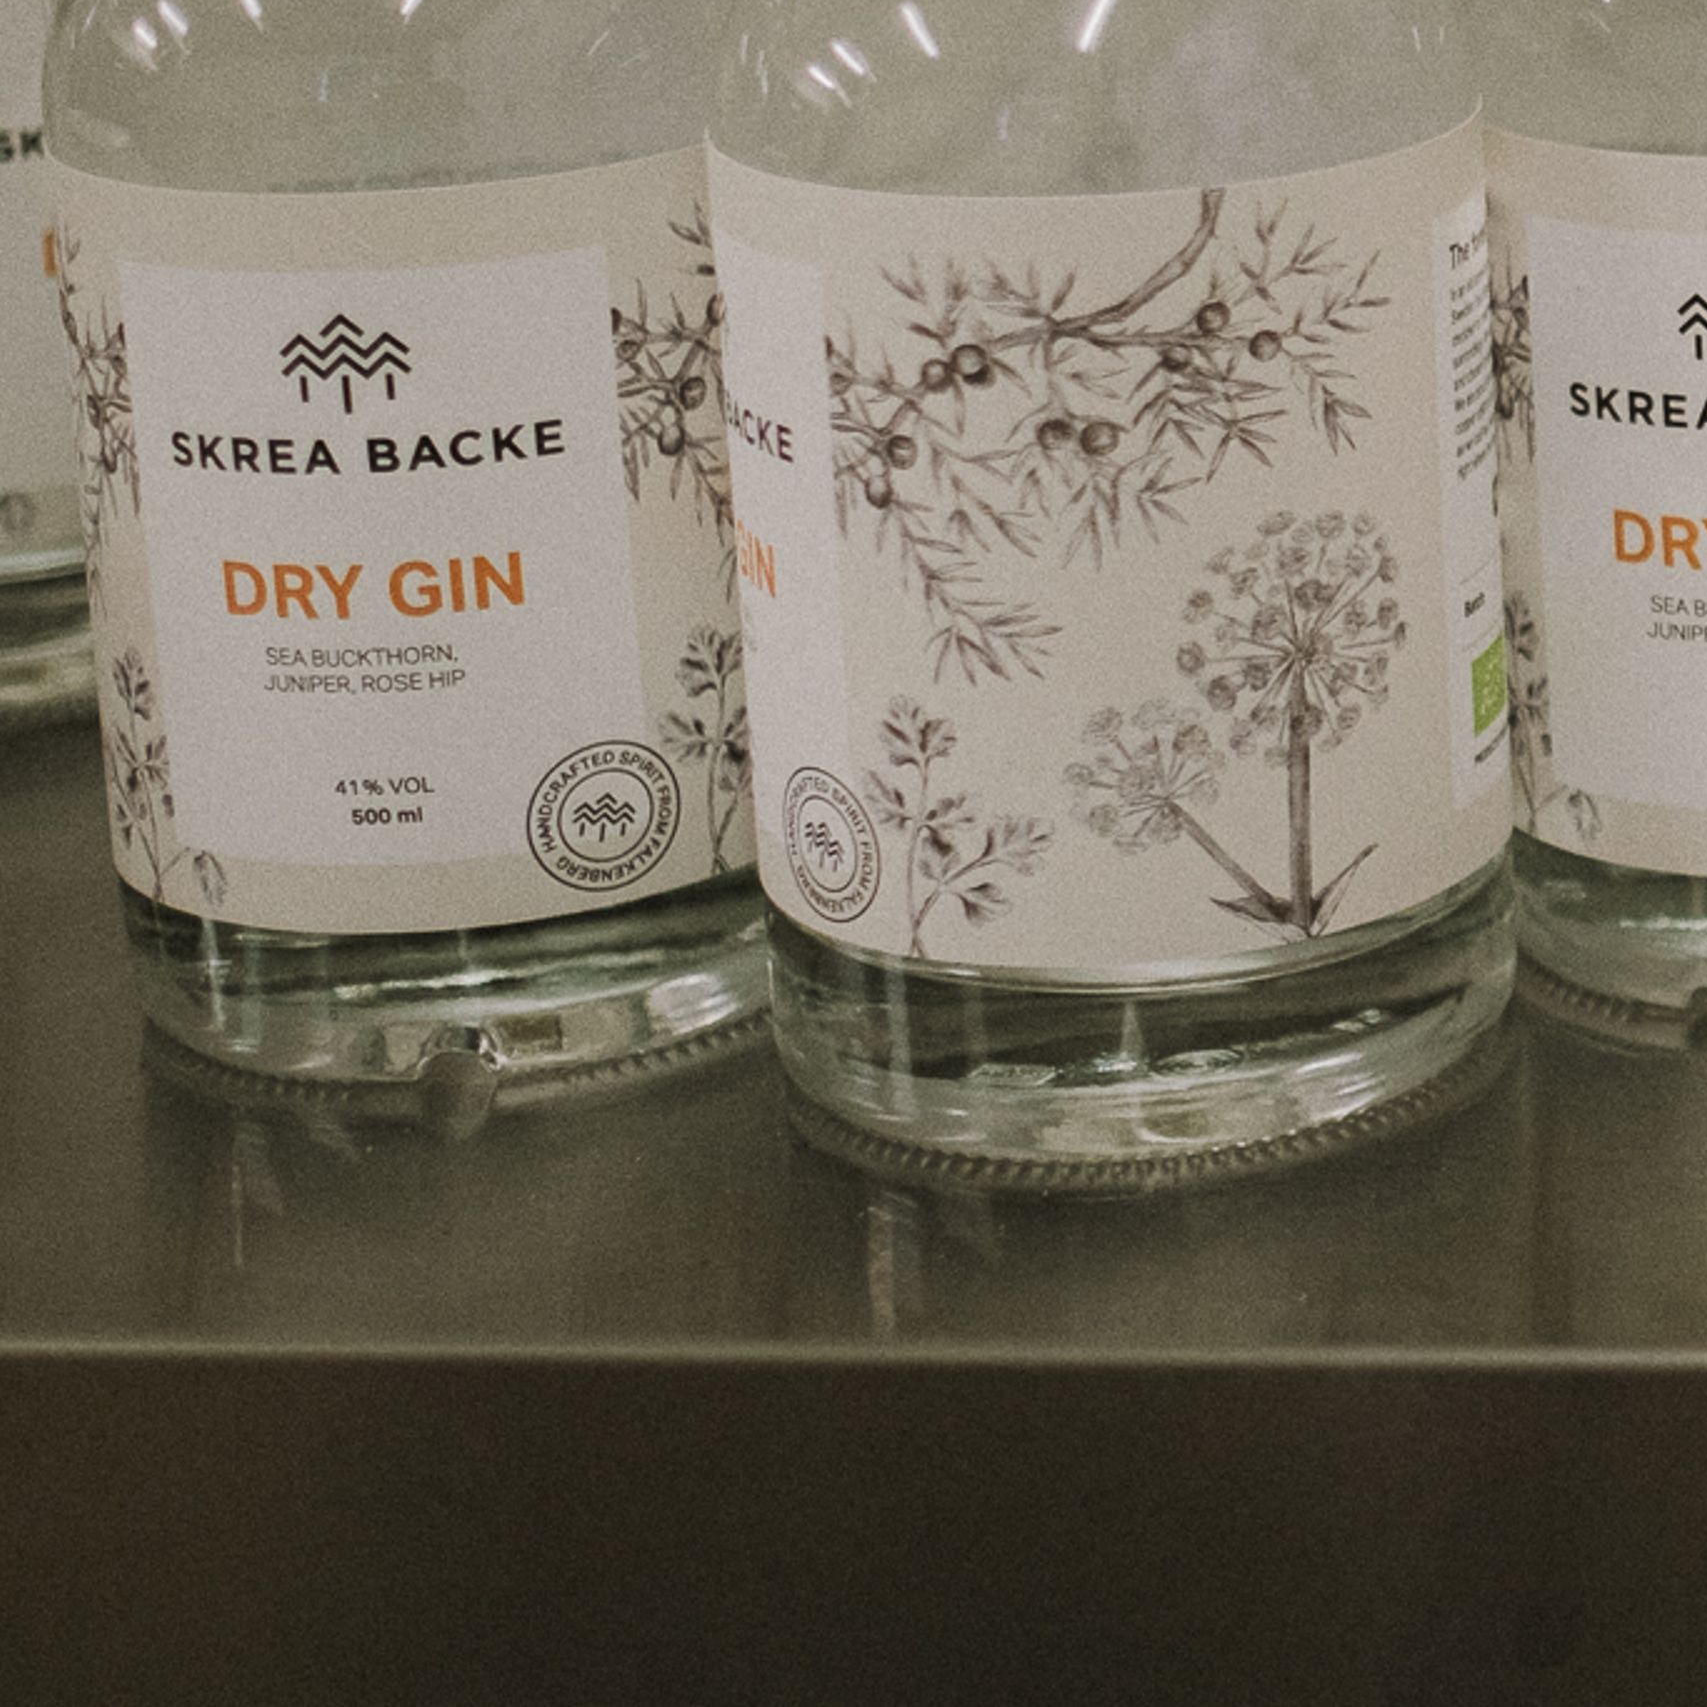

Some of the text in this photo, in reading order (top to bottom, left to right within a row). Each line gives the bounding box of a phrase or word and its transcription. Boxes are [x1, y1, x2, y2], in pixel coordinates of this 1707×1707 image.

[172, 419, 564, 474] SKREA BACKE
[223, 552, 524, 619] DRY GIN
[1651, 596, 1688, 615] SEA
[266, 645, 458, 667] SEA BUCKTHORN,
[264, 669, 466, 694] JUNIPER, ROSE HIP
[388, 777, 434, 794] VOL
[352, 807, 423, 825] 500 ml
[538, 750, 672, 882] HANDCRAFTED SPIRIT FROM FALKENBERG
